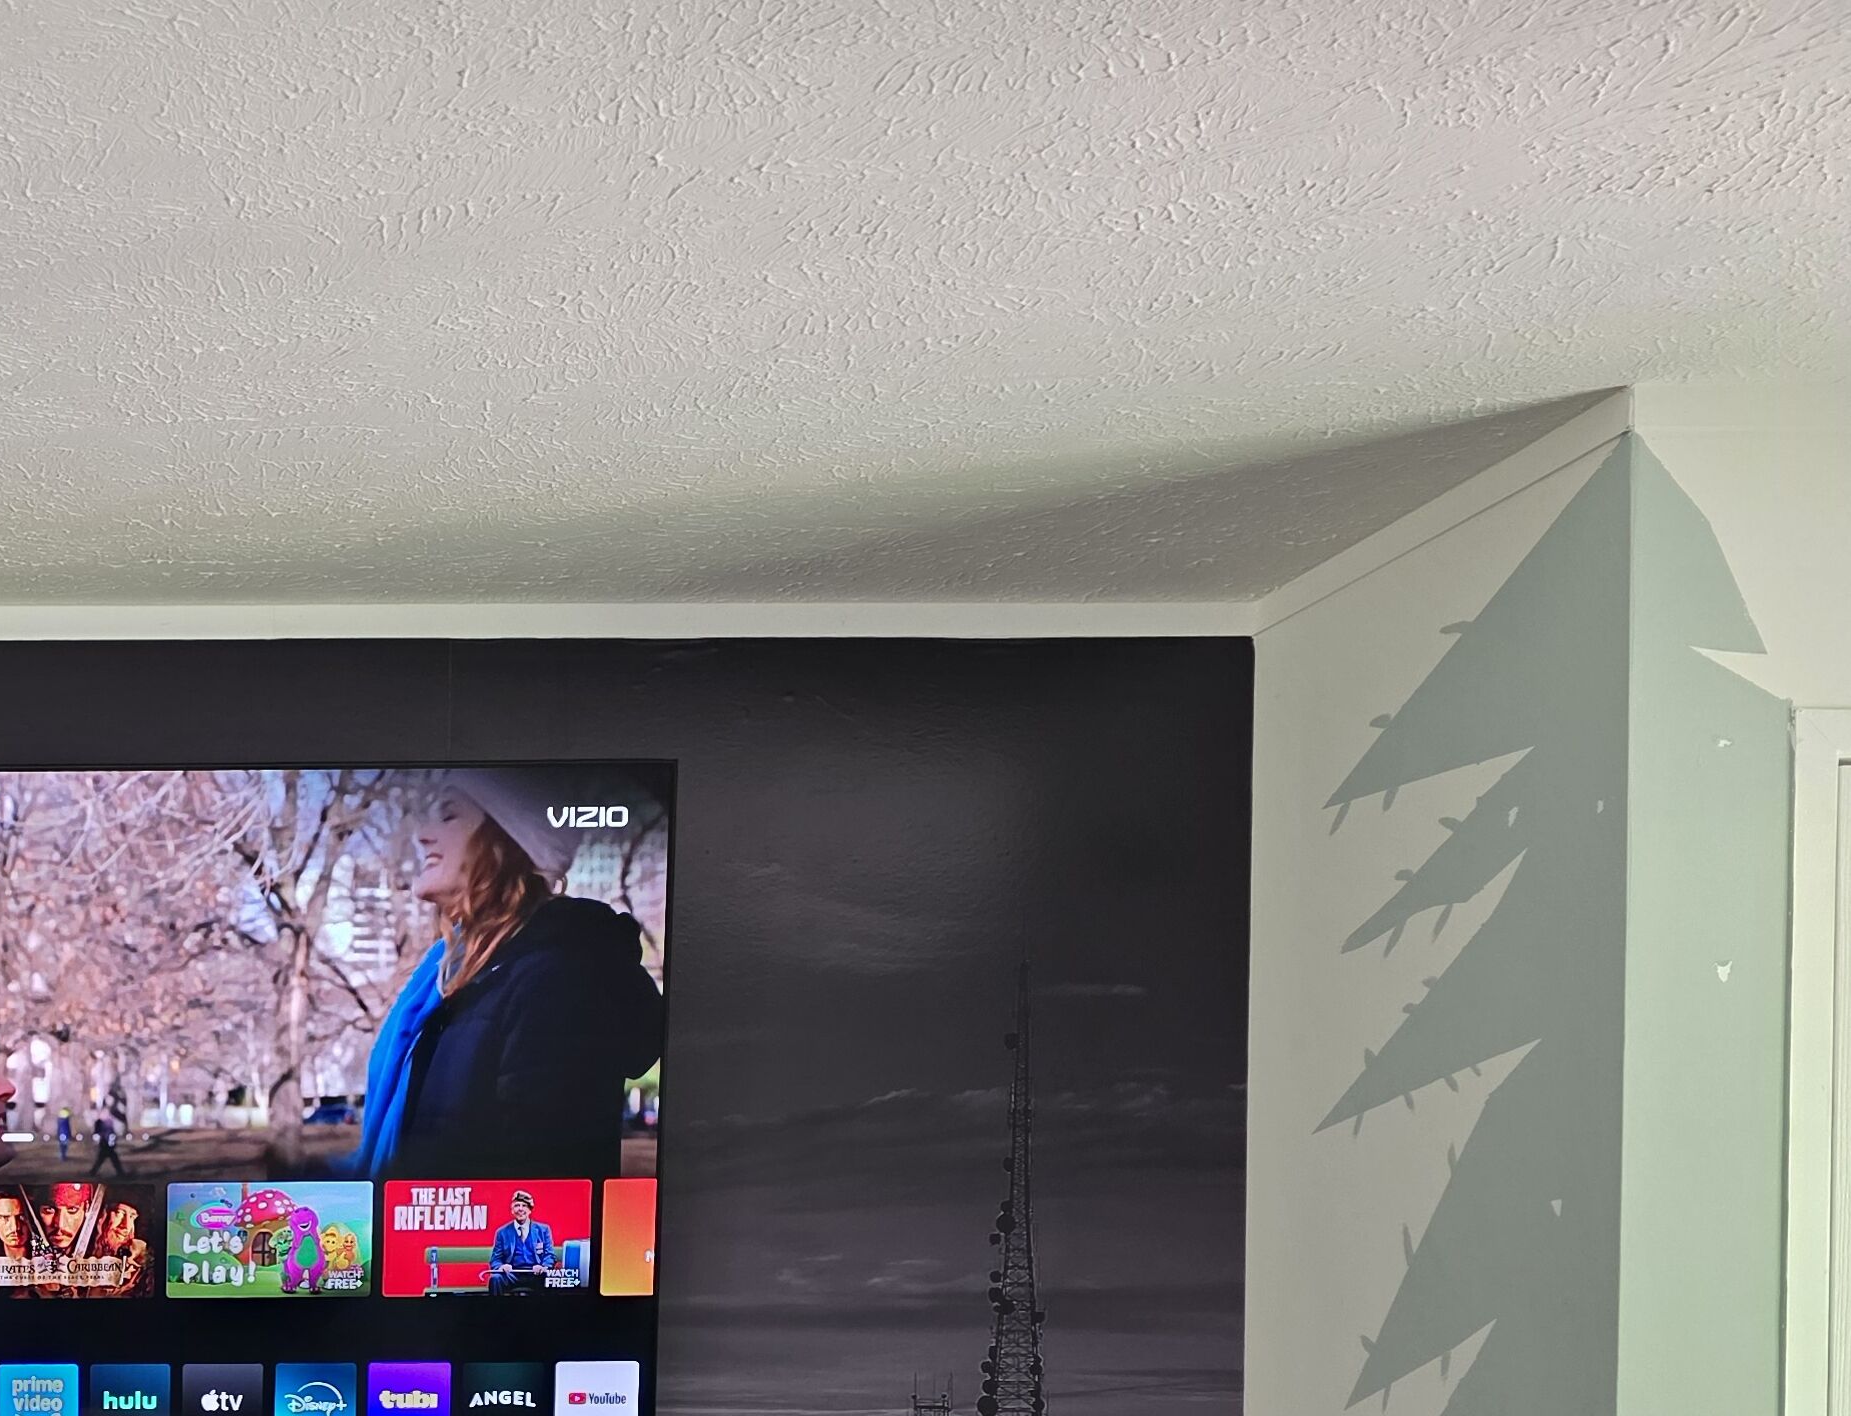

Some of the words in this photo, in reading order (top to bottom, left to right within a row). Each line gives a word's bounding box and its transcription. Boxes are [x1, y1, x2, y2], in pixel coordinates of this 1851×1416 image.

[547, 806, 628, 828] VIZIO
[410, 1188, 436, 1205] THE
[438, 1188, 471, 1205] LAST
[394, 1206, 487, 1230] RIFLEMAN
[183, 1231, 243, 1254] Let's
[67, 1260, 122, 1274] CARIBBEAN
[183, 1260, 256, 1286] Play!
[546, 1269, 578, 1277] WATCH
[324, 1279, 363, 1289] FREE+
[545, 1278, 580, 1288] FREE+
[12, 1375, 63, 1395] prime
[13, 1394, 63, 1412] video
[103, 1391, 157, 1410] hulu
[219, 1392, 243, 1411] tv
[284, 1391, 347, 1416] Disney+
[379, 1390, 438, 1409] tubi
[469, 1390, 536, 1408] ANGEL
[589, 1392, 626, 1405] YouTube
